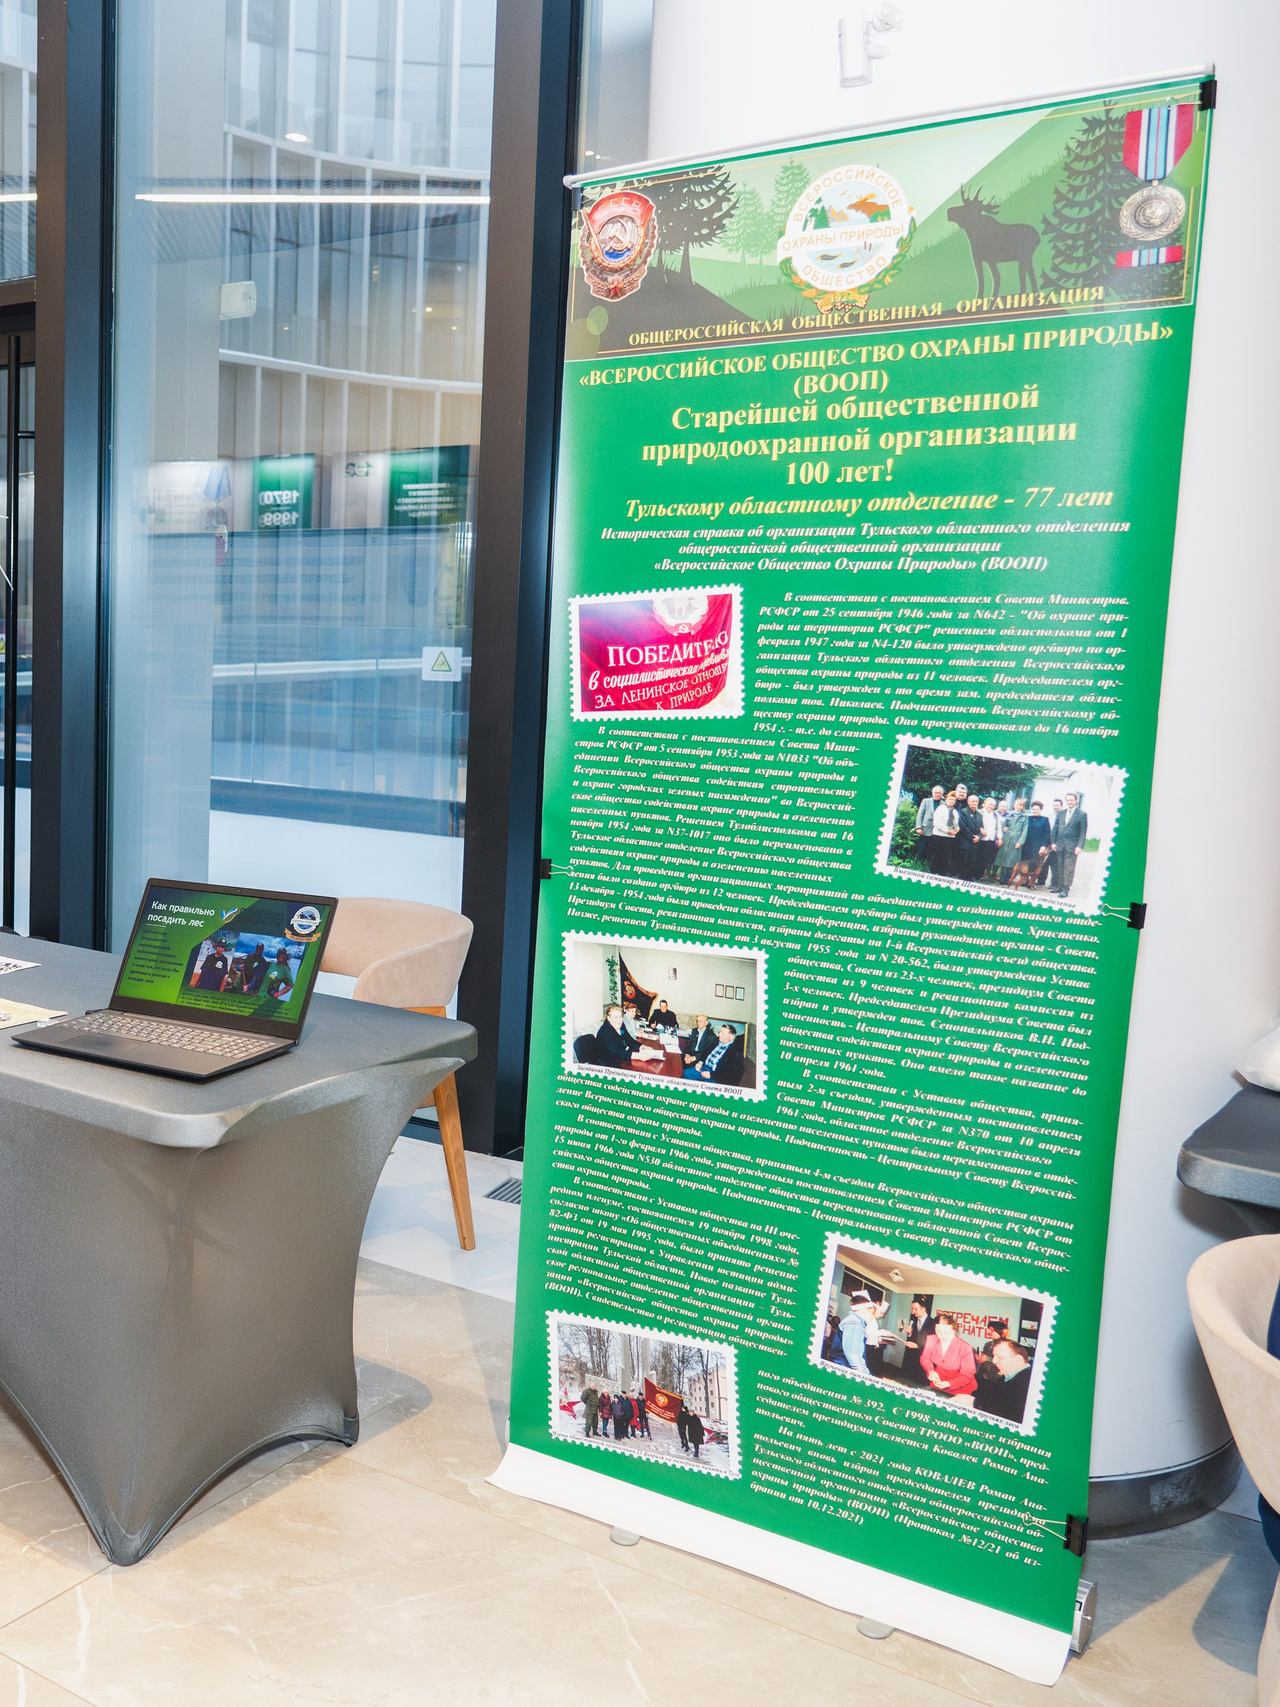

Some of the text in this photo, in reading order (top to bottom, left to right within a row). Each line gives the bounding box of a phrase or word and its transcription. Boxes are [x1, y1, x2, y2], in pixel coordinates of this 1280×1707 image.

[598, 196, 643, 214] СССР
[793, 168, 903, 223] ВСЕРОССИЙСКОЕ
[782, 224, 905, 253] ОХРАНЫ ПРИРОДЫ
[802, 255, 888, 288] ОБЩЕСТВО
[629, 286, 1103, 345] ОБЩЕРОССИЙСКАЯ ОБЩЕСТВЕННАЯ ОРГАНИЗАЦИЯ
[579, 321, 1173, 386] «ВСЕРОССИЙСКОЕ ОБЩЕСТВО ОХРАНЫ ПРИРОДЫ»
[793, 370, 889, 399] (ВООП)
[672, 390, 1039, 432] Старейшей общественной
[642, 423, 1076, 466] природоохранной организации
[787, 457, 894, 485] 100 лет!
[627, 500, 725, 522] Тульскому
[728, 496, 863, 518] областному
[867, 491, 998, 512] отделение
[1025, 487, 1054, 507] 77
[1057, 492, 1113, 507] лет
[601, 521, 1130, 542] Историческая справка об организации Тульского областного отделения
[678, 540, 1001, 556] общероссийской общественной организации
[654, 557, 1047, 574] «Всероссийское Общество Охраны Природы» (ВООП)
[784, 592, 793, 602] В
[794, 595, 878, 603] соответствии
[890, 595, 992, 604] постановлением
[995, 594, 1043, 604] Совета
[1048, 594, 1129, 608] Министров.
[756, 652, 1125, 671] ганизации Тульского областного отделения Всероссийского
[594, 694, 615, 709] ЗА
[621, 679, 689, 705] ЛЕНИНСКОЕ
[691, 662, 729, 685] ОТНОШЕ
[670, 682, 713, 709] ПРИРОДЕ
[571, 830, 852, 870] Тульское областное отделение Всероссийского общества
[147, 914, 205, 927] посадить лес
[151, 901, 215, 916] Как правильно
[778, 1425, 793, 1437] На
[796, 1433, 823, 1446] пять
[825, 1443, 847, 1454] лет
[859, 1451, 884, 1464] 2021
[887, 1461, 911, 1473] года
[915, 1466, 976, 1490] КОВАЛЕВ
[979, 1484, 1016, 1502] Роман
[1019, 1498, 1047, 1511] Ана-
[750, 1481, 864, 1525] брании от 10.12.2021)
